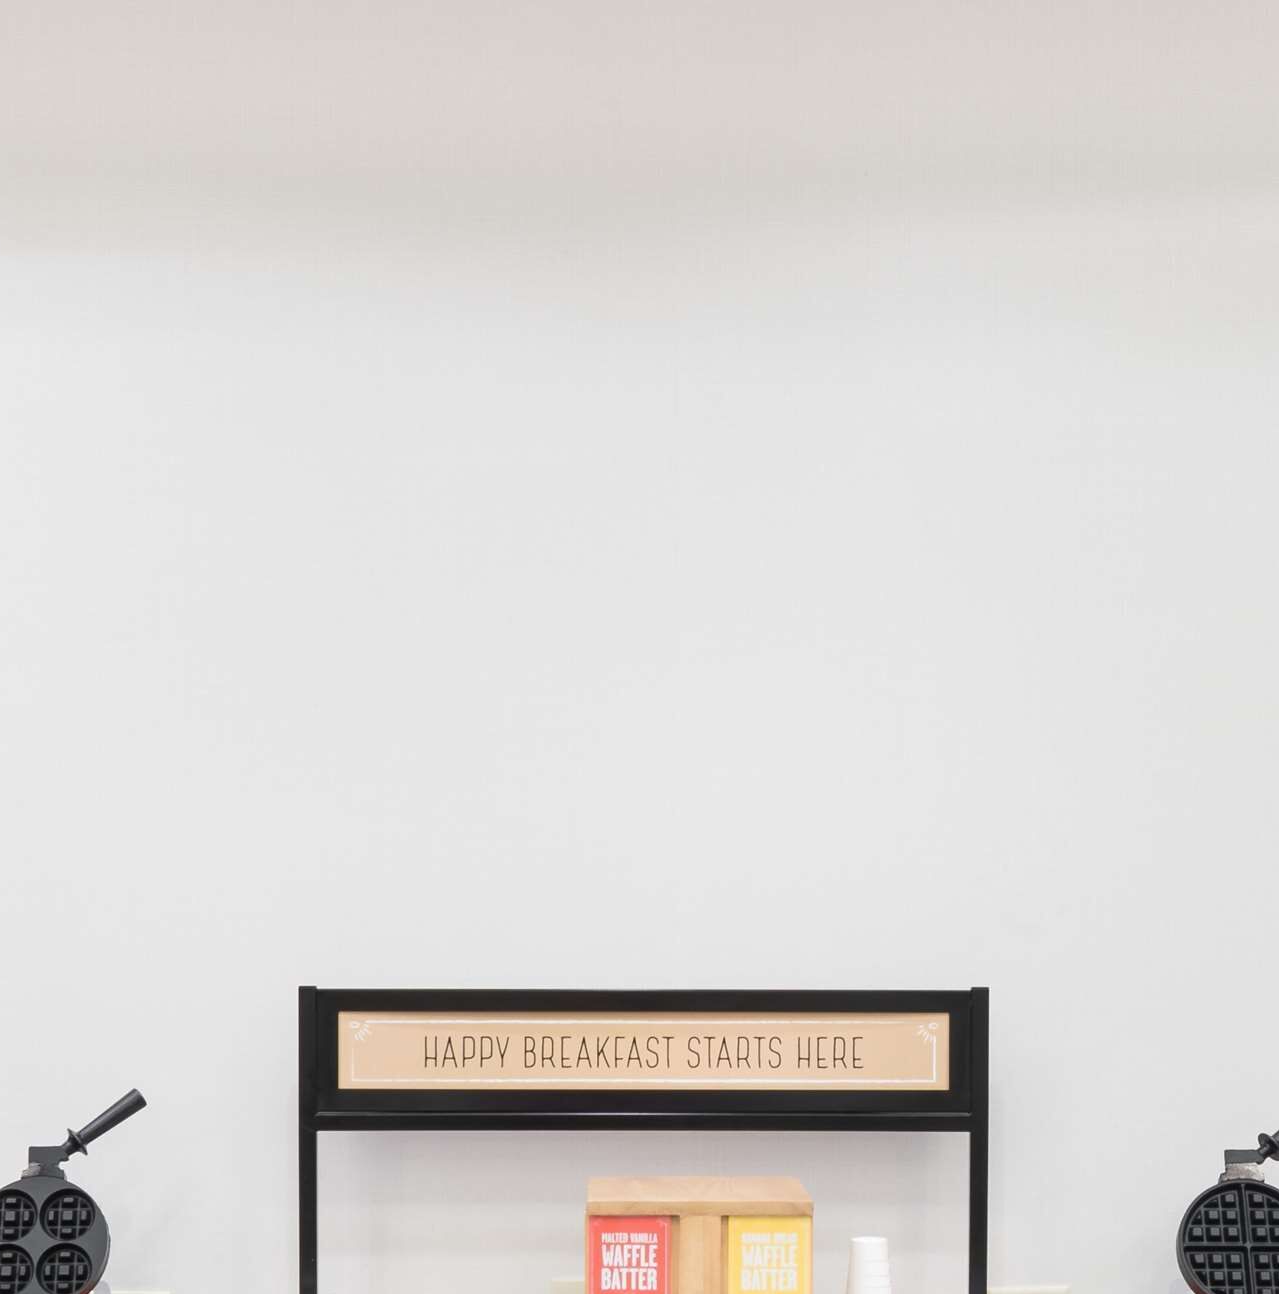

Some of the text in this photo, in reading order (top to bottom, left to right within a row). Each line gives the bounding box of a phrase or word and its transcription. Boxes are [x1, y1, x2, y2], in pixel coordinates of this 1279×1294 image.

[424, 1035, 864, 1069] HAPPY BREAKFAST STARTS HERE
[601, 1232, 658, 1243] MALTED VANILLA
[601, 1244, 658, 1267] WAFFLE
[741, 1245, 798, 1267] WAFFLE
[600, 1267, 658, 1291] BATTER
[740, 1267, 798, 1291] BATTER
